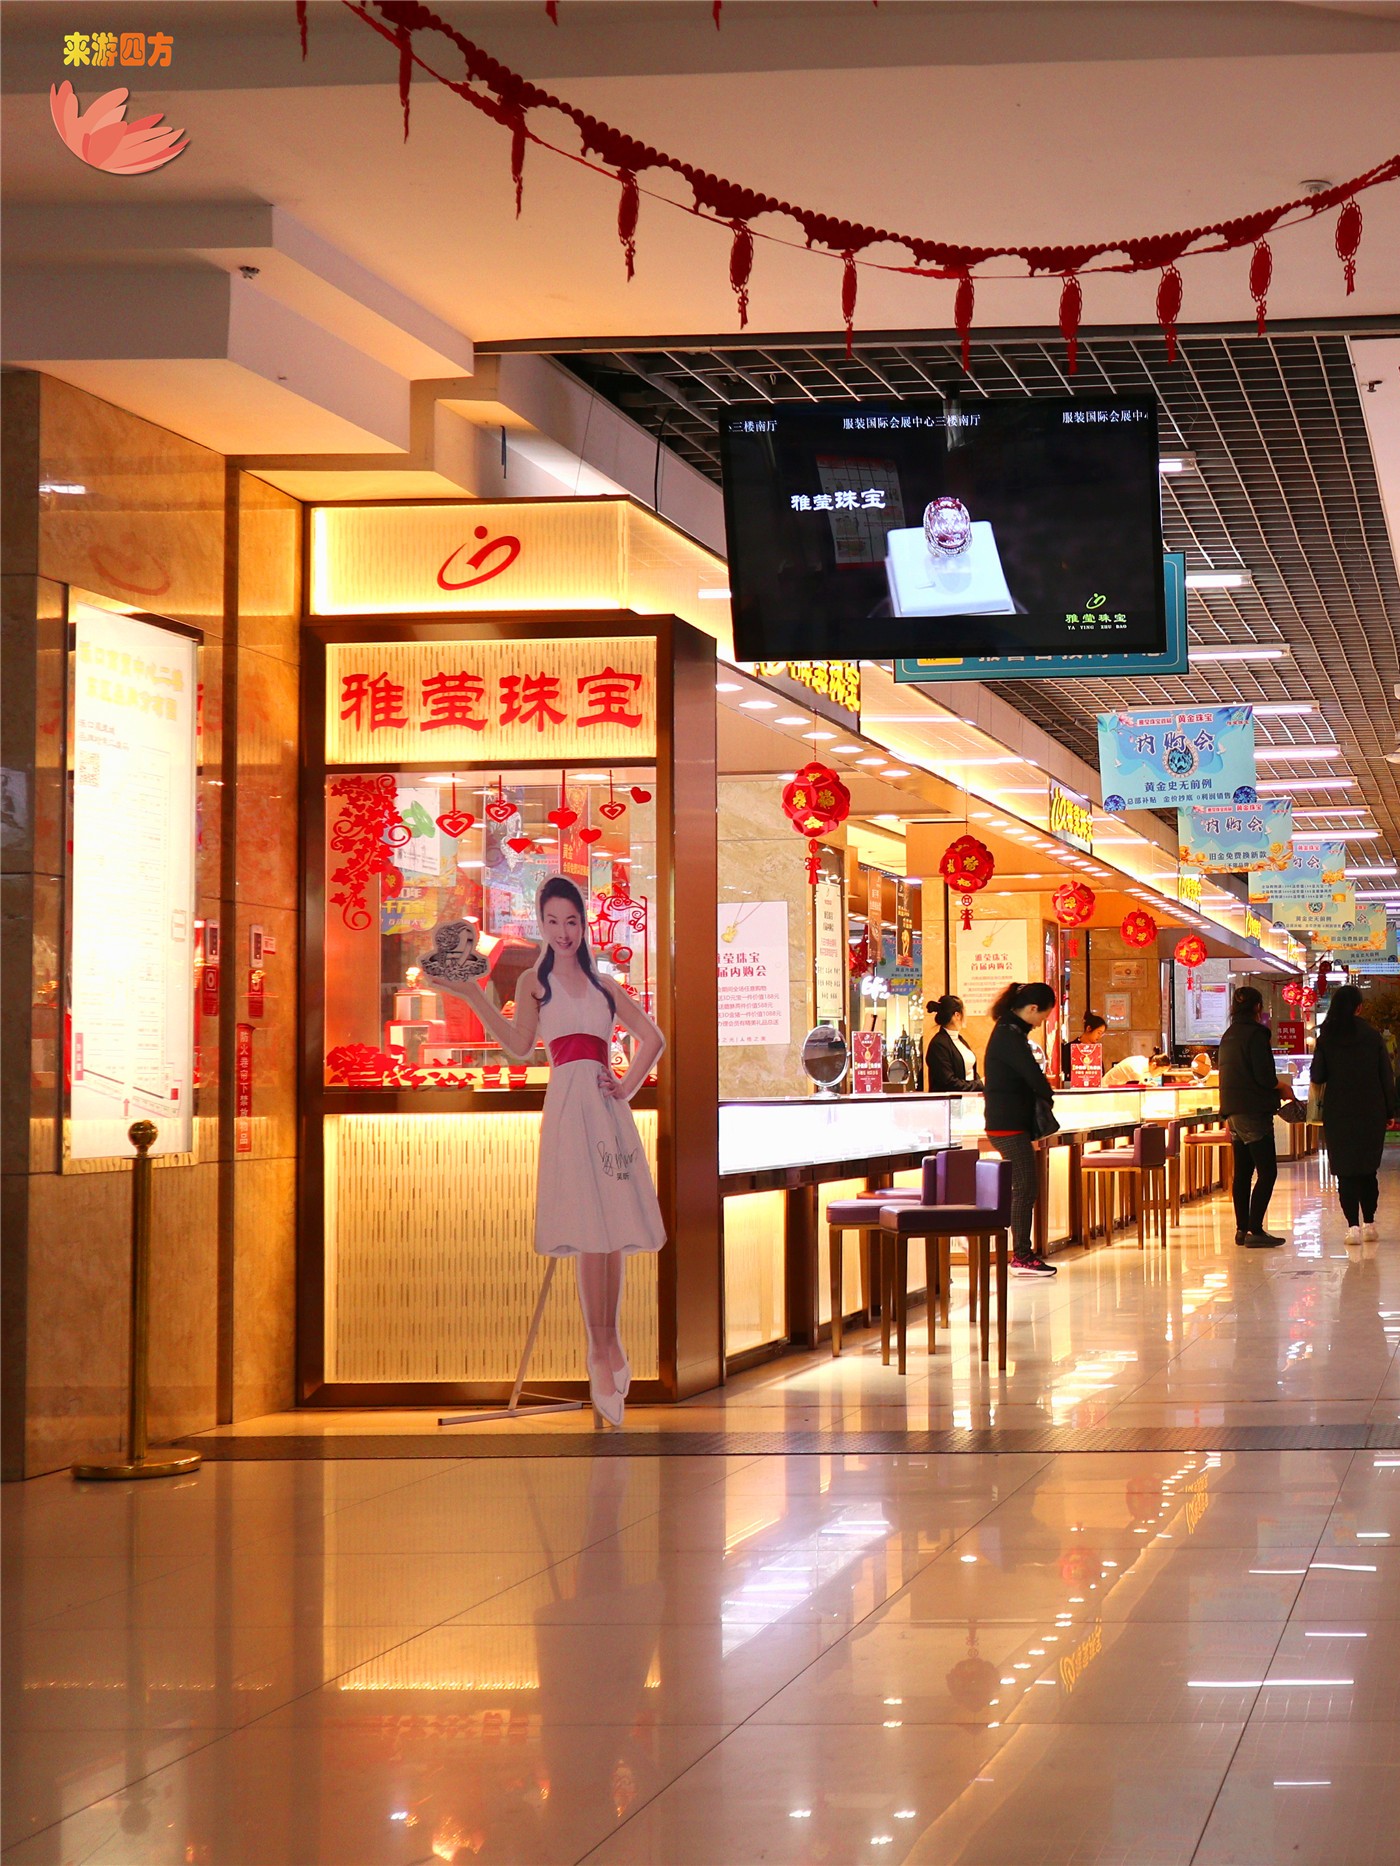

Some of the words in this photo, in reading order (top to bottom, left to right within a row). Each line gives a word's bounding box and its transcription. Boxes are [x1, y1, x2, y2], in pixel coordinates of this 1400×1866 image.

[728, 420, 778, 432] 三楼南厅
[842, 413, 981, 430] 服装国际会展中心三楼南厅
[1062, 410, 1148, 424] 服装国际会展中
[790, 488, 886, 512] 雅莹珠宝
[1065, 613, 1127, 624] 雅莹珠宝
[340, 666, 643, 733] 雅莹珠宝
[1178, 713, 1213, 723] 黄金珠宝
[1137, 730, 1215, 754] 内购会
[1144, 779, 1212, 792] 黄金史无前例
[1206, 816, 1263, 834] 内购会
[1209, 851, 1267, 861] 旧金免费换新款
